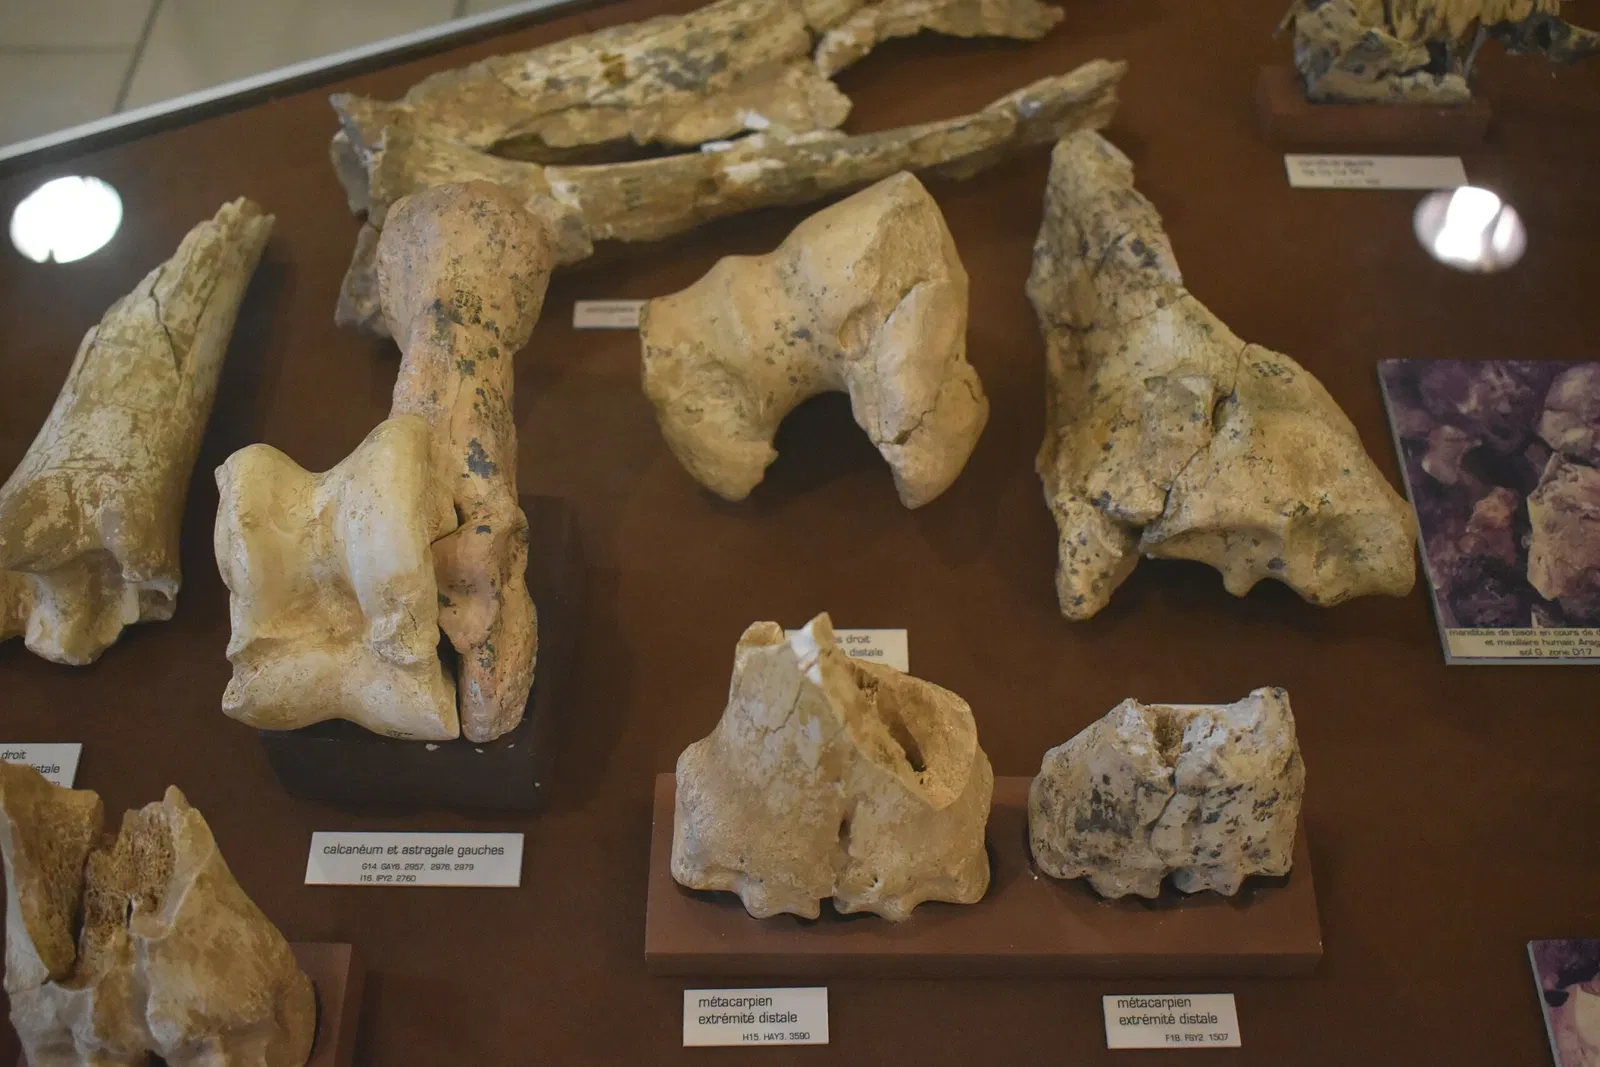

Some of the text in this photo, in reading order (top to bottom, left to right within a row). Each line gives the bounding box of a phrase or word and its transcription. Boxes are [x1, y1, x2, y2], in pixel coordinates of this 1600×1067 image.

[1, 749, 27, 760] droit
[323, 844, 504, 857] calcanéum et astragale gauches
[396, 874, 416, 882] 2760
[698, 996, 772, 1009] métacarpien
[1117, 998, 1191, 1010] métacarpien
[698, 1011, 797, 1024] extrémité distale
[1119, 1012, 1218, 1025] extrémité distale
[789, 1032, 810, 1040] 3590
[1208, 1033, 1229, 1041] 1507
